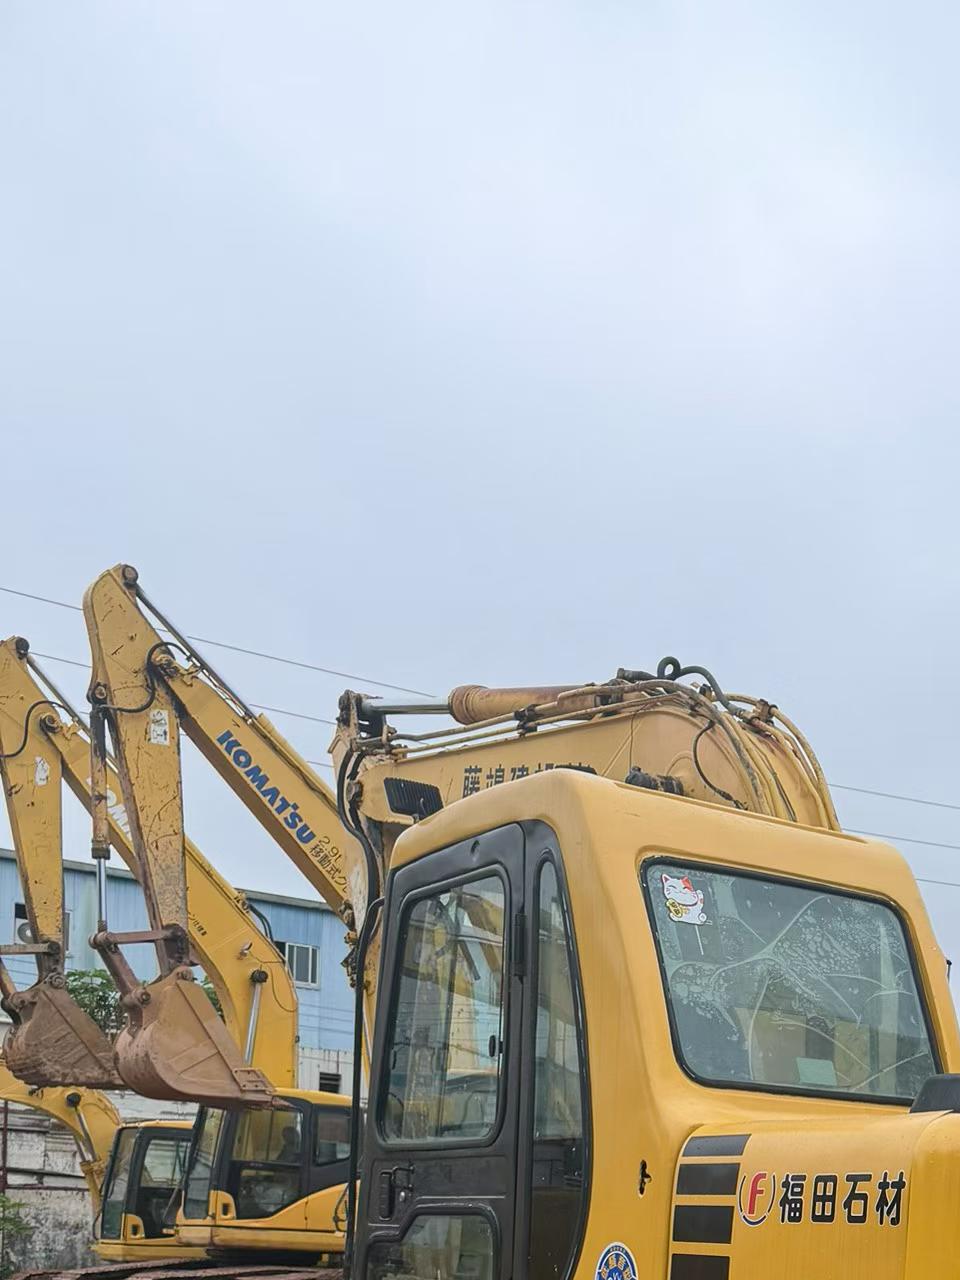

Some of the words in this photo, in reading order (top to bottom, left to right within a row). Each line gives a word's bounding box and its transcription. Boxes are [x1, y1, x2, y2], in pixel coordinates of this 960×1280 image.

[216, 730, 317, 845] KOMATSU
[779, 1171, 906, 1226] 福田石材
